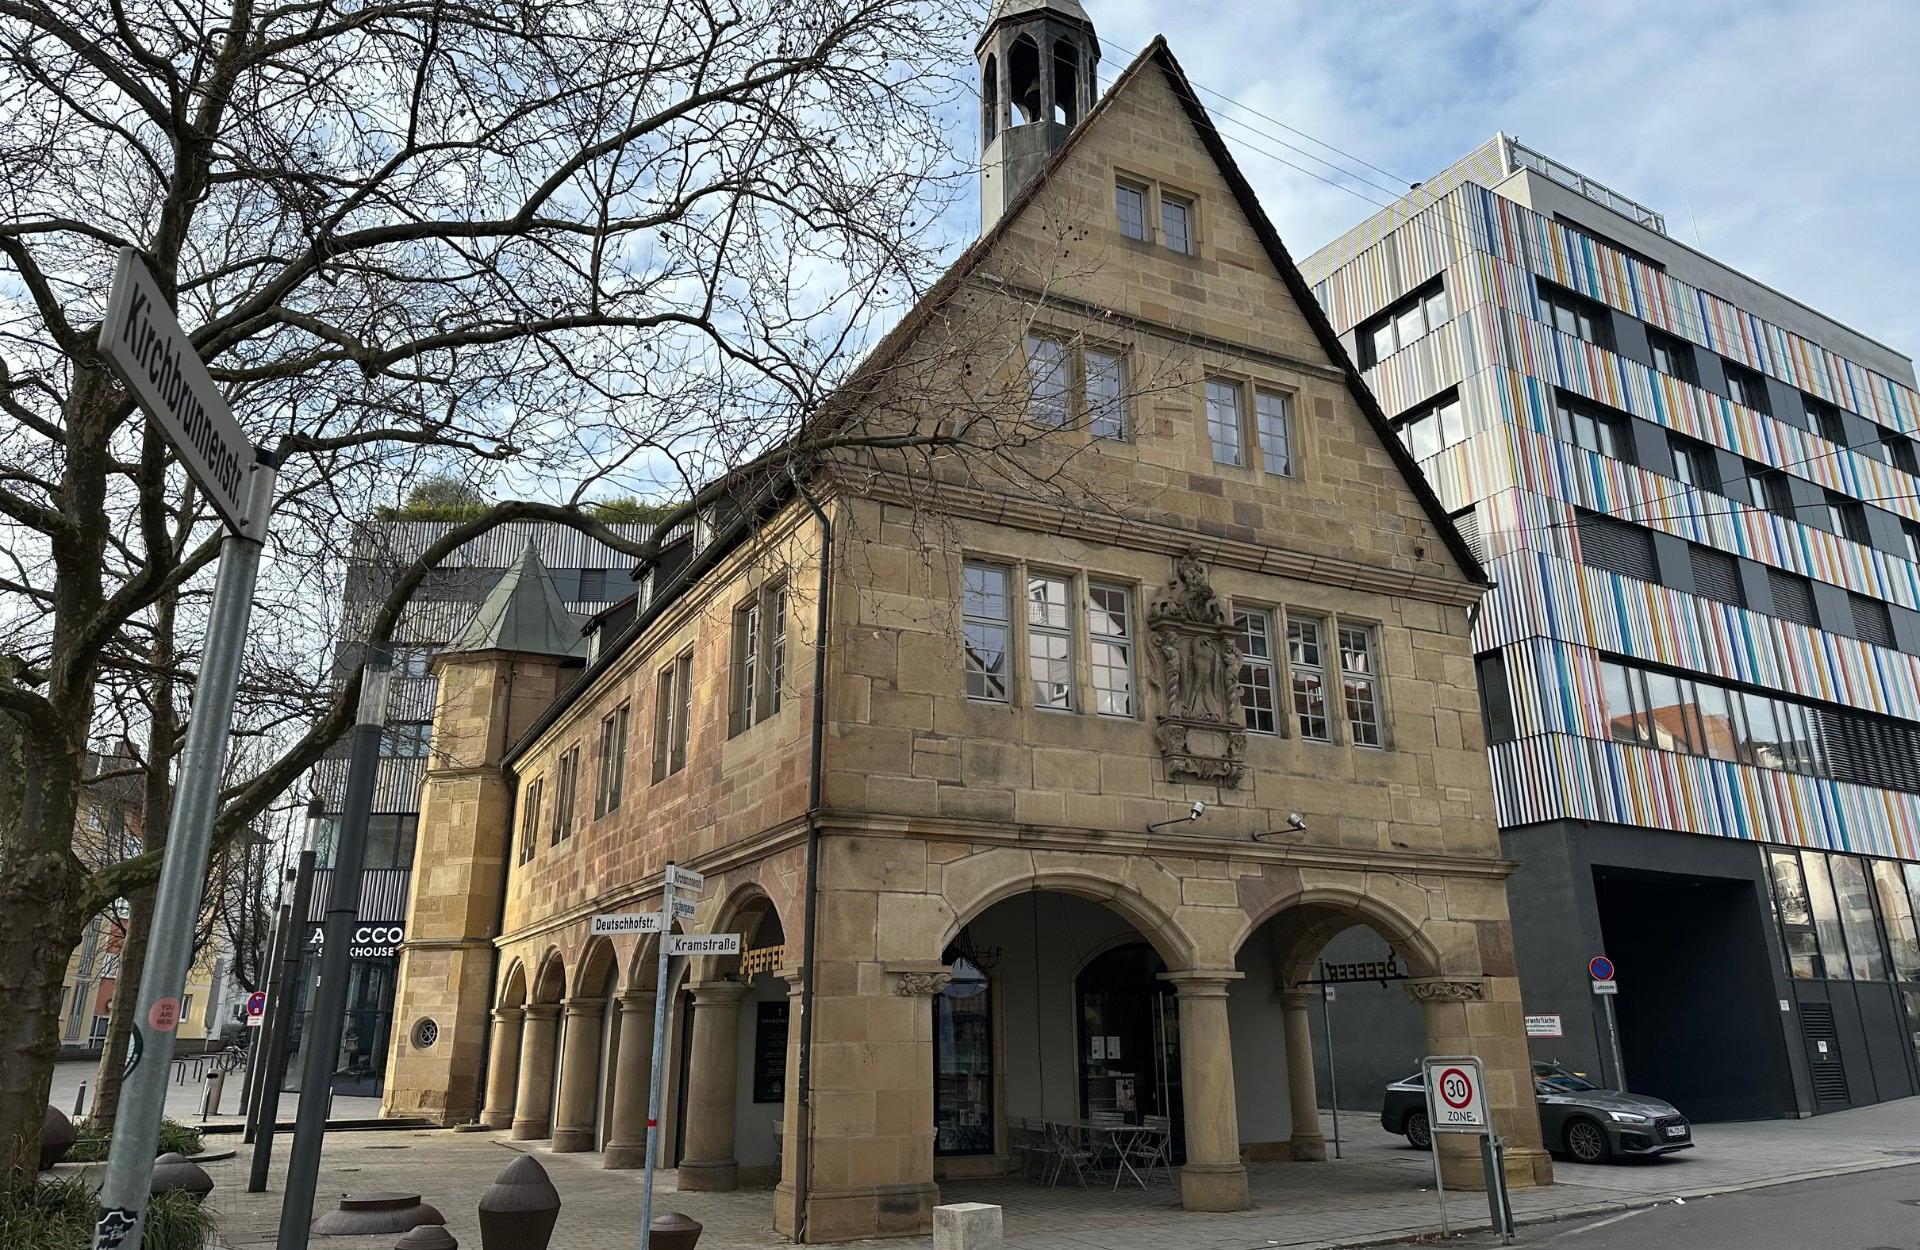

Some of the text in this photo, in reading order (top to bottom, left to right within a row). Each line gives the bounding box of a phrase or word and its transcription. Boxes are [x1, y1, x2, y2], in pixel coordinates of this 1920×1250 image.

[123, 281, 243, 510] Kirchbrunnenstr.
[595, 916, 656, 931] Deutschhofstr.
[310, 927, 404, 944] ACCO
[675, 937, 737, 951] Kramstraße
[1446, 1079, 1466, 1098] 30
[1447, 1111, 1472, 1122] ZONE
